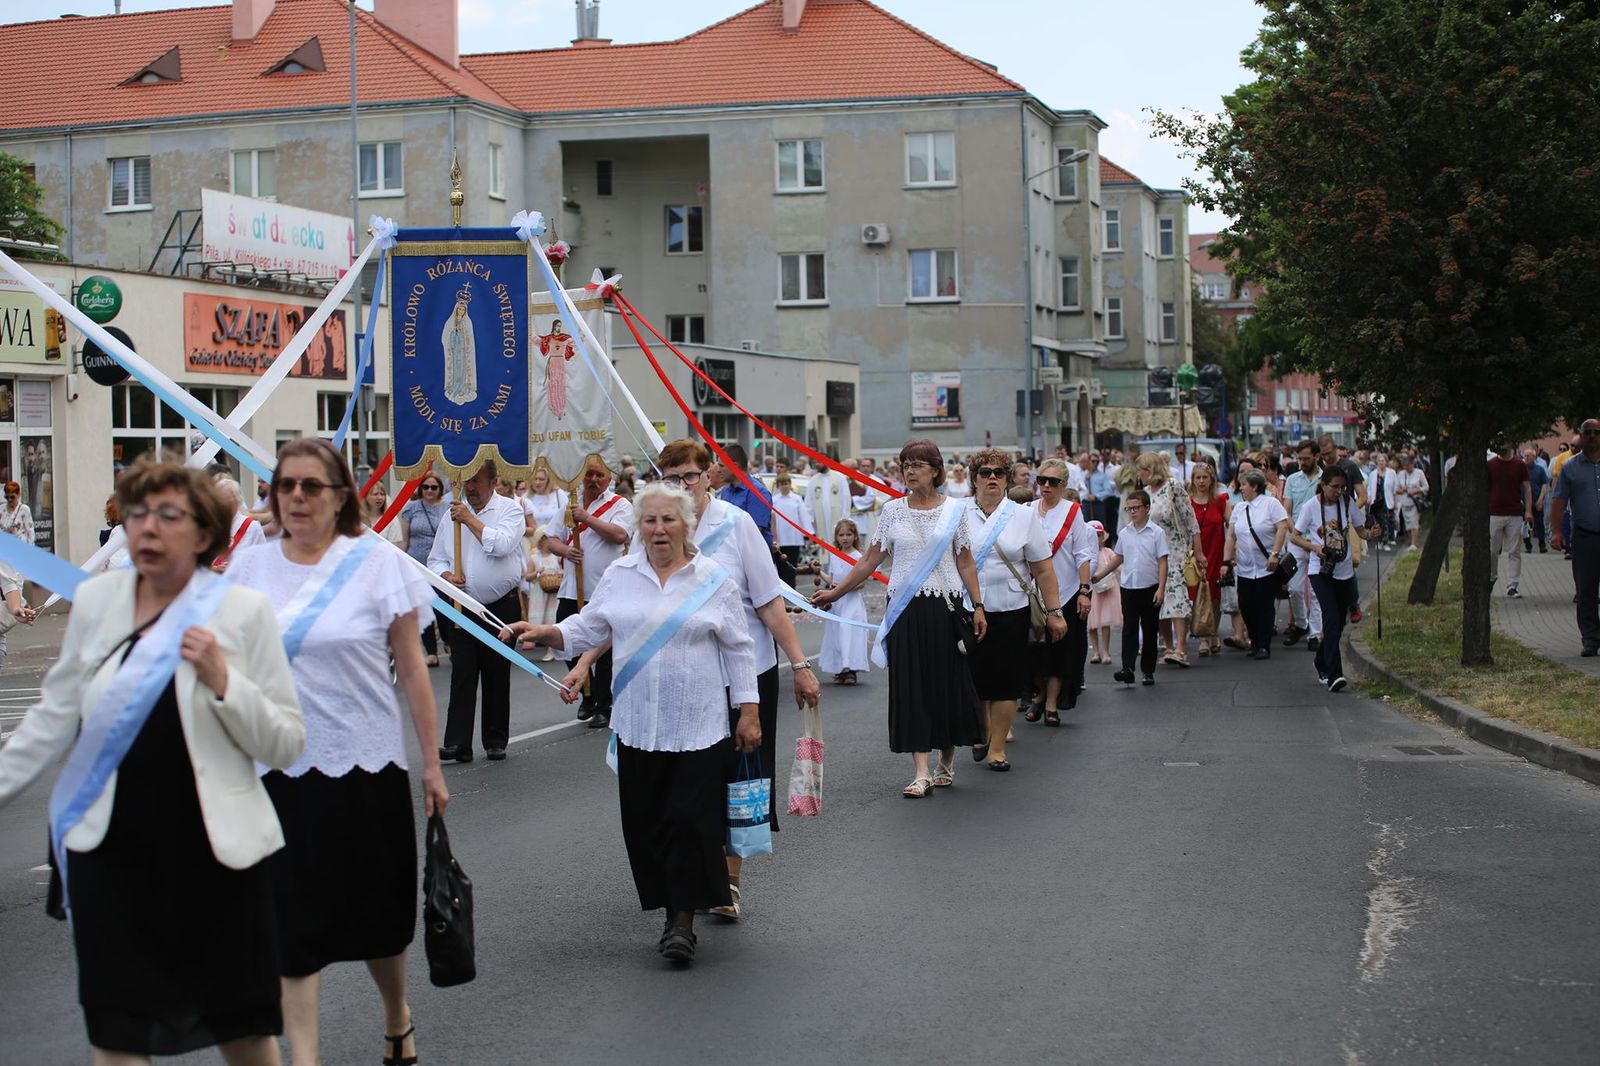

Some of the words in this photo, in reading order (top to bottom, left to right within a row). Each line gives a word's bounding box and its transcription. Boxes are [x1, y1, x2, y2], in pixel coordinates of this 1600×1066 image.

[425, 258, 492, 281] RÓŻAŃCA
[81, 293, 114, 308] Carlsberg
[402, 283, 426, 358] KRÓLOWO
[493, 283, 516, 358] ŚWIĘTEGO
[212, 302, 281, 348] SZAFA
[409, 385, 436, 424] MÓDL
[440, 417, 463, 434] SIĘ
[469, 416, 489, 430] ZA
[487, 384, 513, 419] NAMI
[548, 430, 571, 441] UFAM
[578, 430, 607, 441] TOBIE
